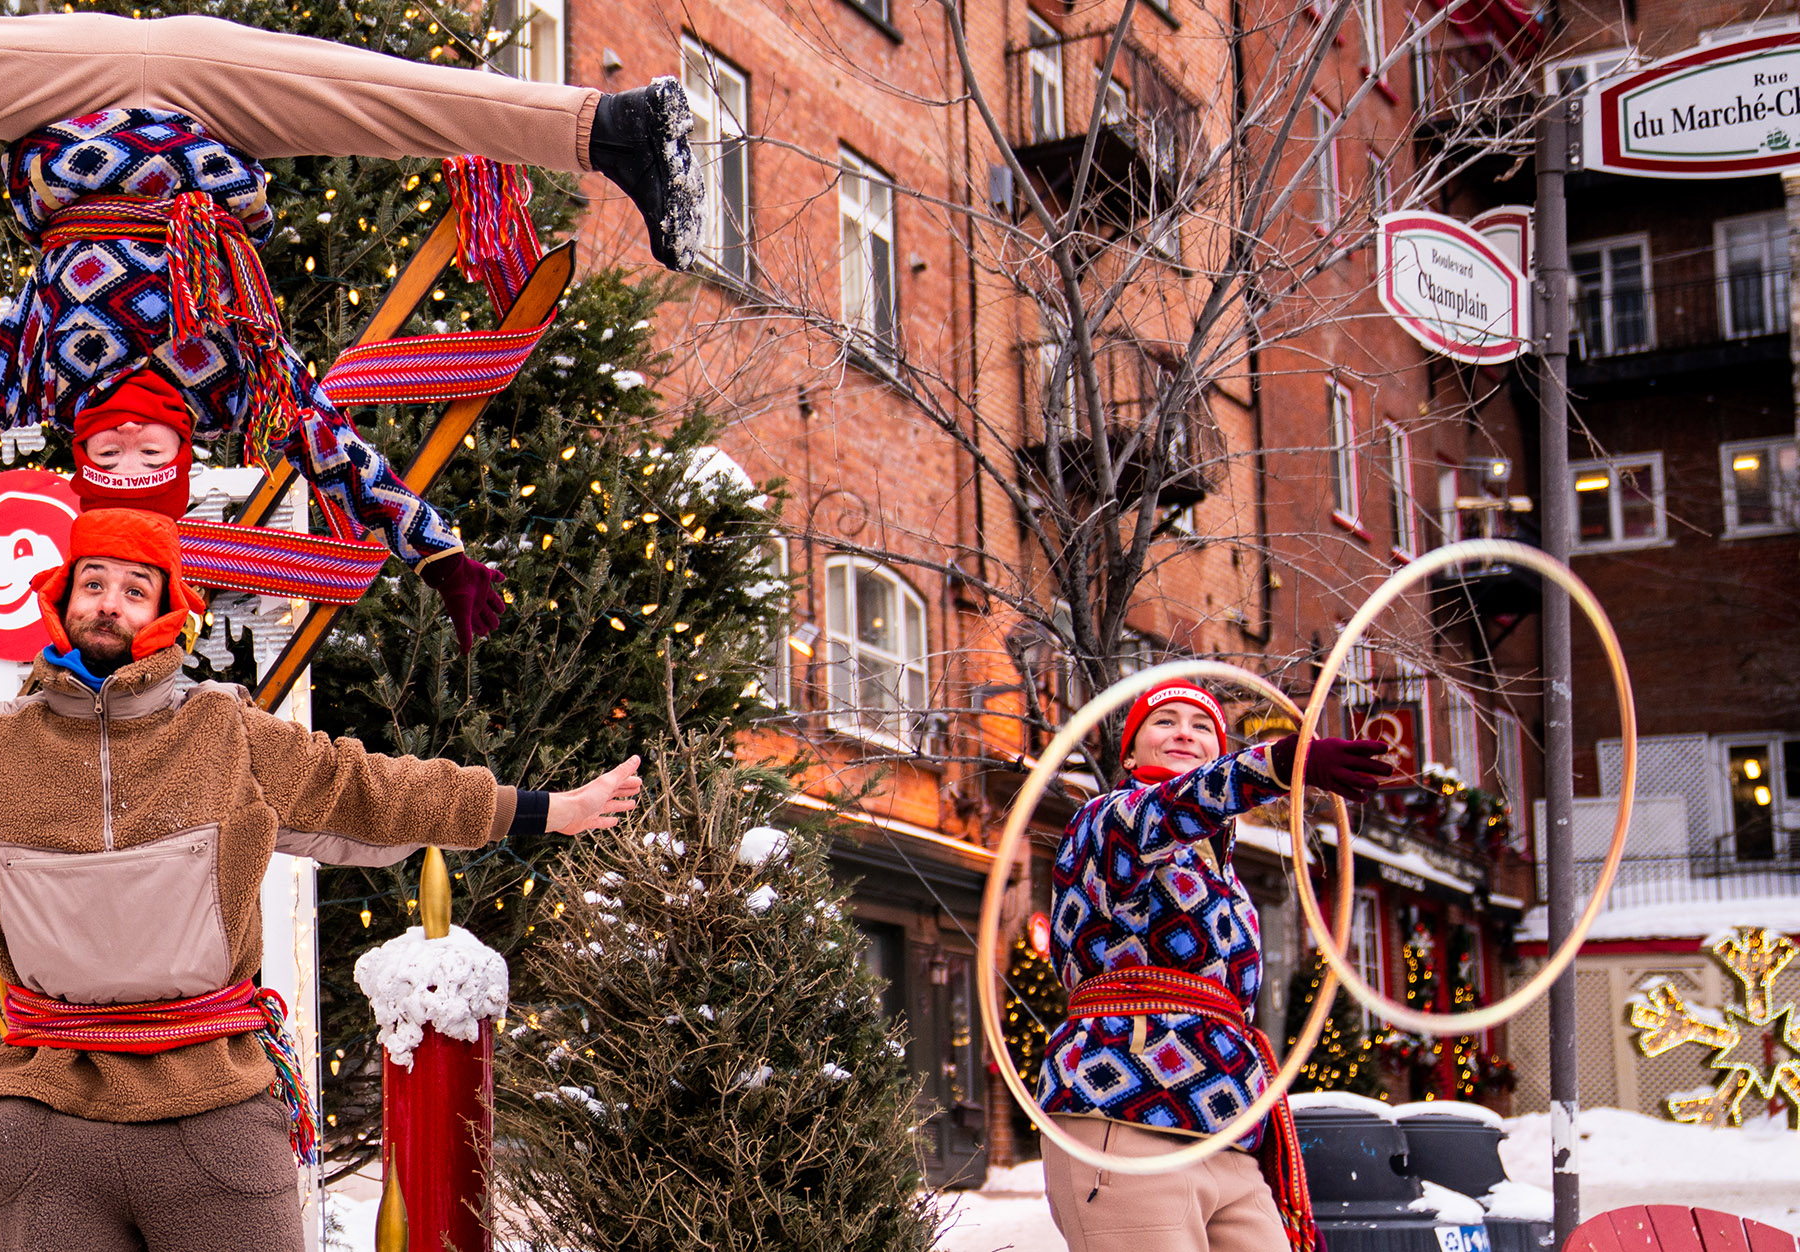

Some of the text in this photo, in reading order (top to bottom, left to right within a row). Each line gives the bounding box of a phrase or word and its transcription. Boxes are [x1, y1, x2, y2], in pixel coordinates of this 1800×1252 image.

[1754, 73, 1788, 87] Rue
[1633, 111, 1665, 139] du
[1432, 249, 1474, 279] Boulevard
[1417, 270, 1488, 322] Champlain
[111, 477, 123, 486] DE
[124, 467, 176, 487] CARNAVAL
[1150, 690, 1188, 704] JOYEUX
